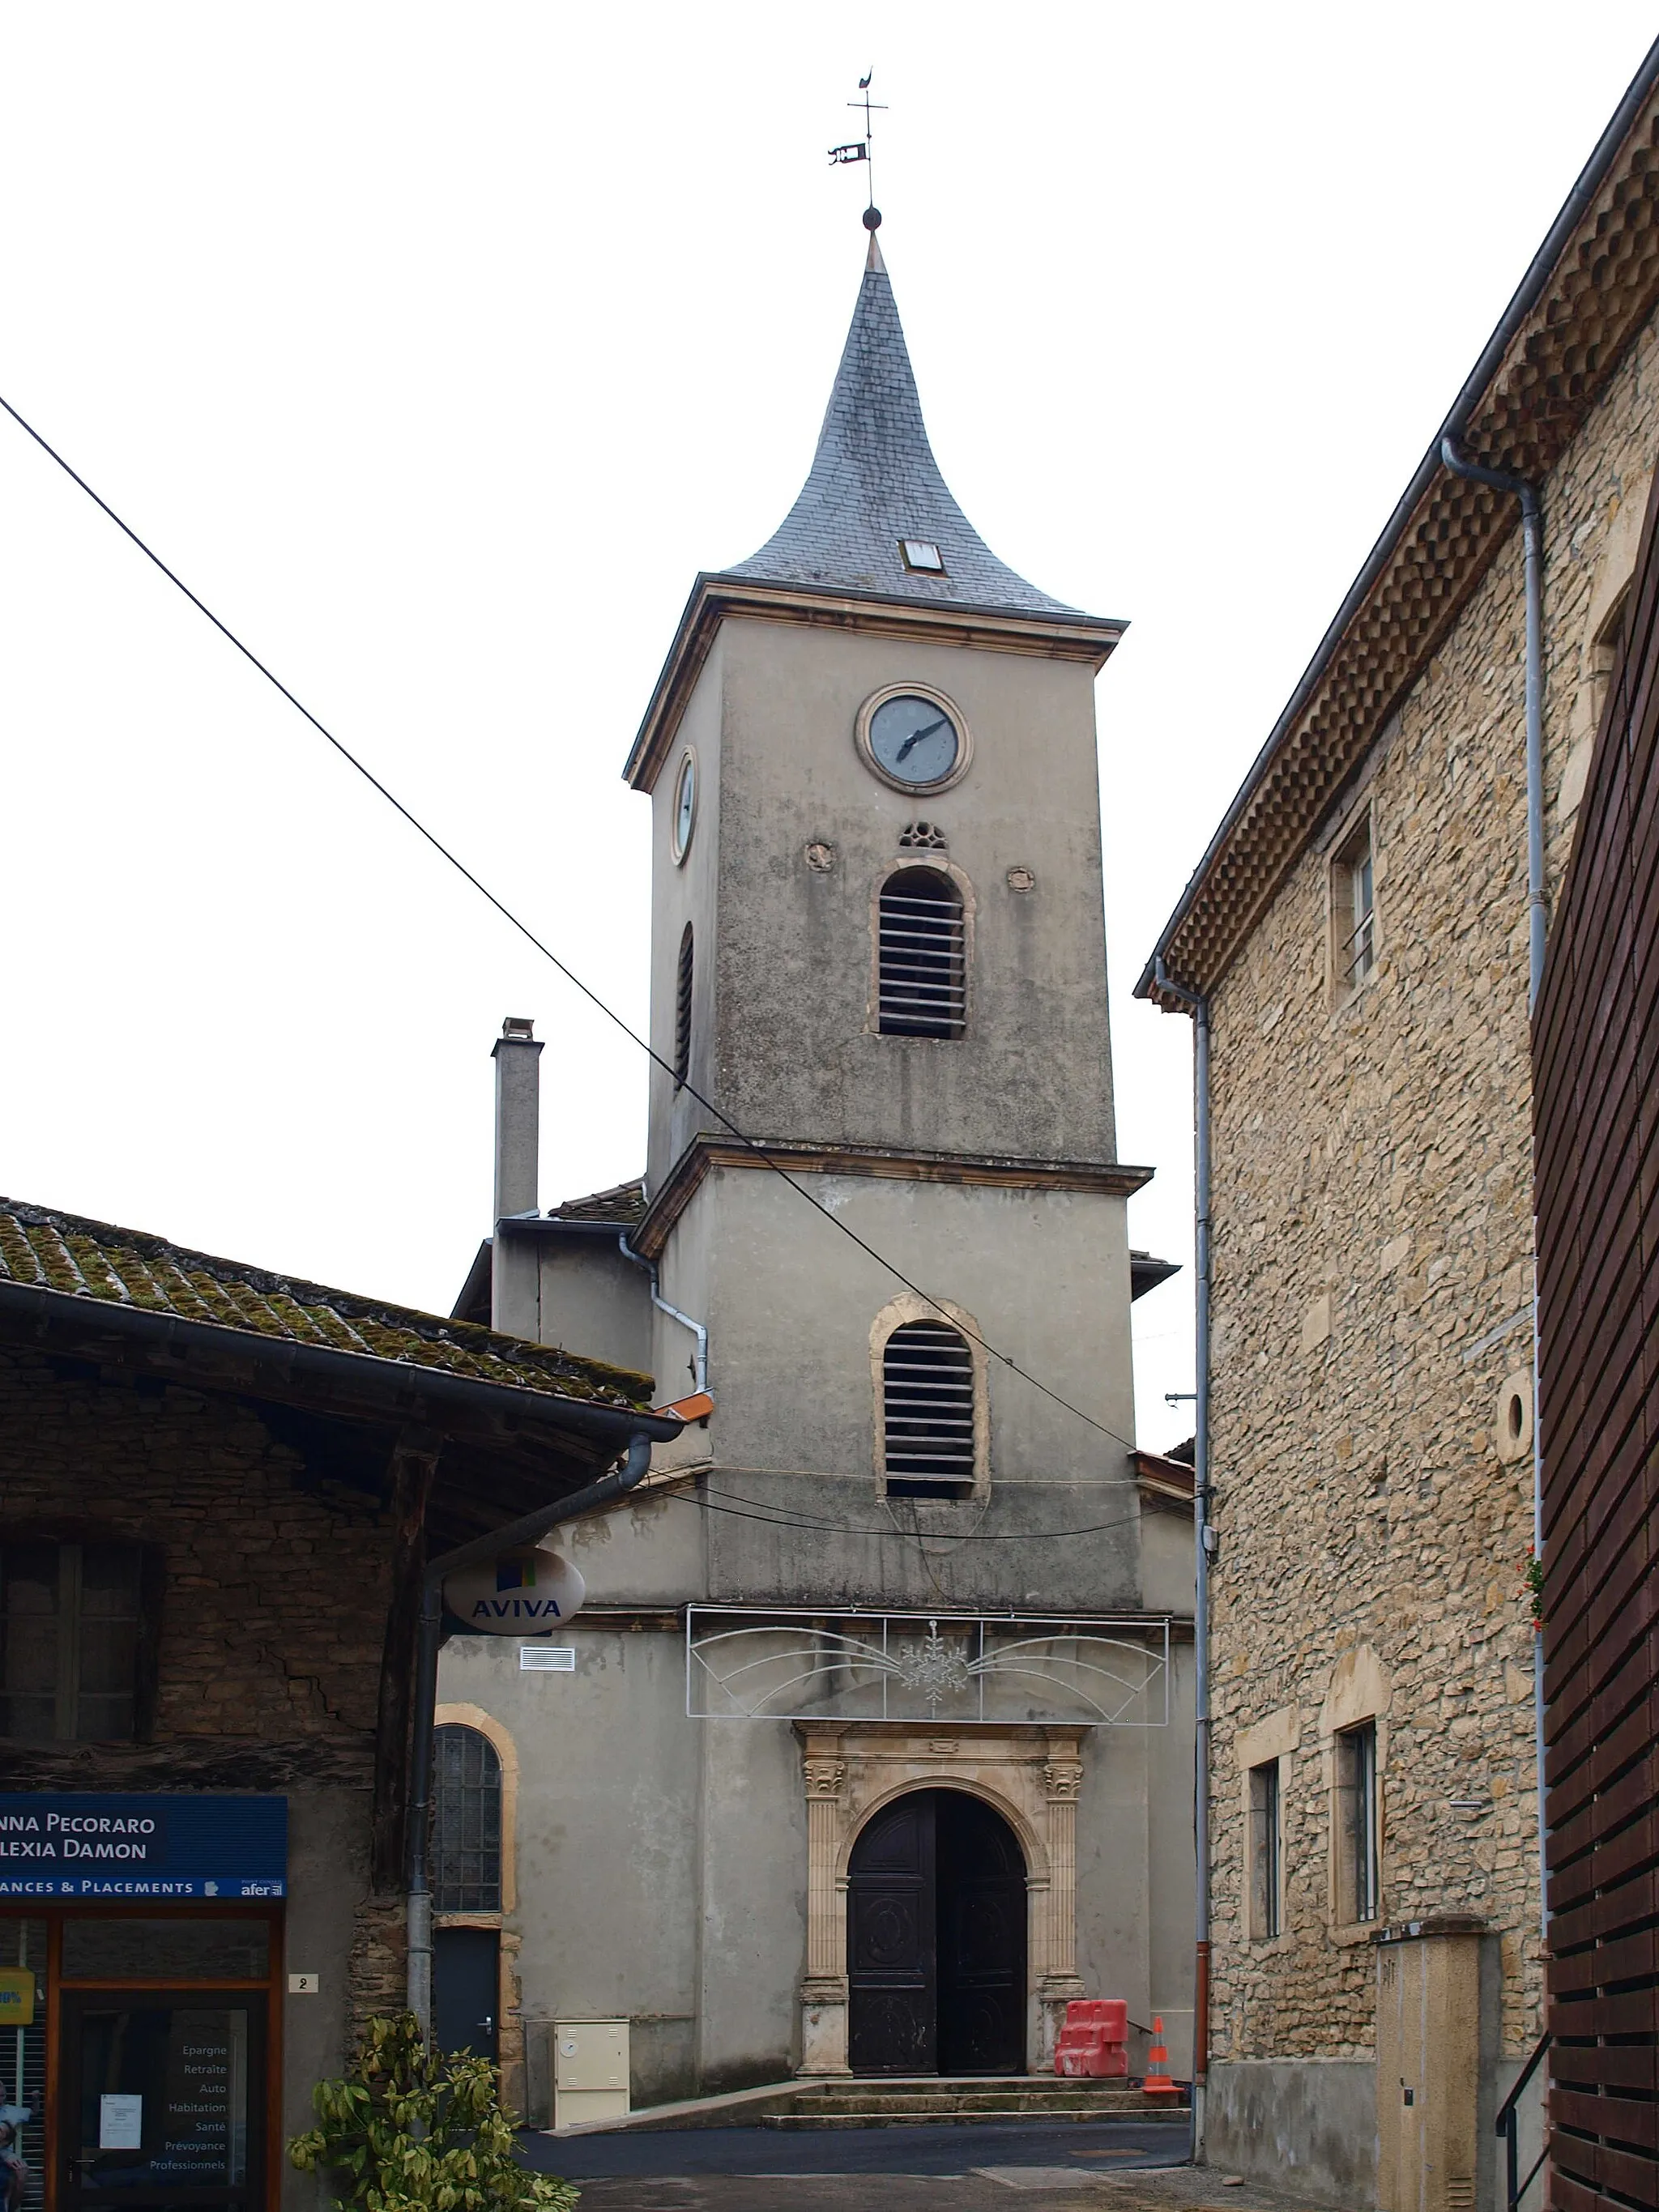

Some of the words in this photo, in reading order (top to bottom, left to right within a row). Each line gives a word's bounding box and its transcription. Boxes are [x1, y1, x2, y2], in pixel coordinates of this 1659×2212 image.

[471, 1600, 561, 1617] AVIVA
[47, 1813, 156, 1834] PECORARO
[0, 1842, 56, 1857] LEXIA
[64, 1839, 147, 1859] DAMON
[61, 1882, 75, 1893] &
[82, 1880, 193, 1893] PLACEMENTS
[241, 1883, 270, 1895] afer
[299, 1977, 307, 1989] 2
[183, 2045, 227, 2057] Epargne
[184, 2065, 228, 2074] Retraite
[199, 2084, 227, 2094] Auto
[168, 2103, 226, 2112] Habitation
[195, 2121, 226, 2132] Santé
[150, 2160, 225, 2170] Professionnels
